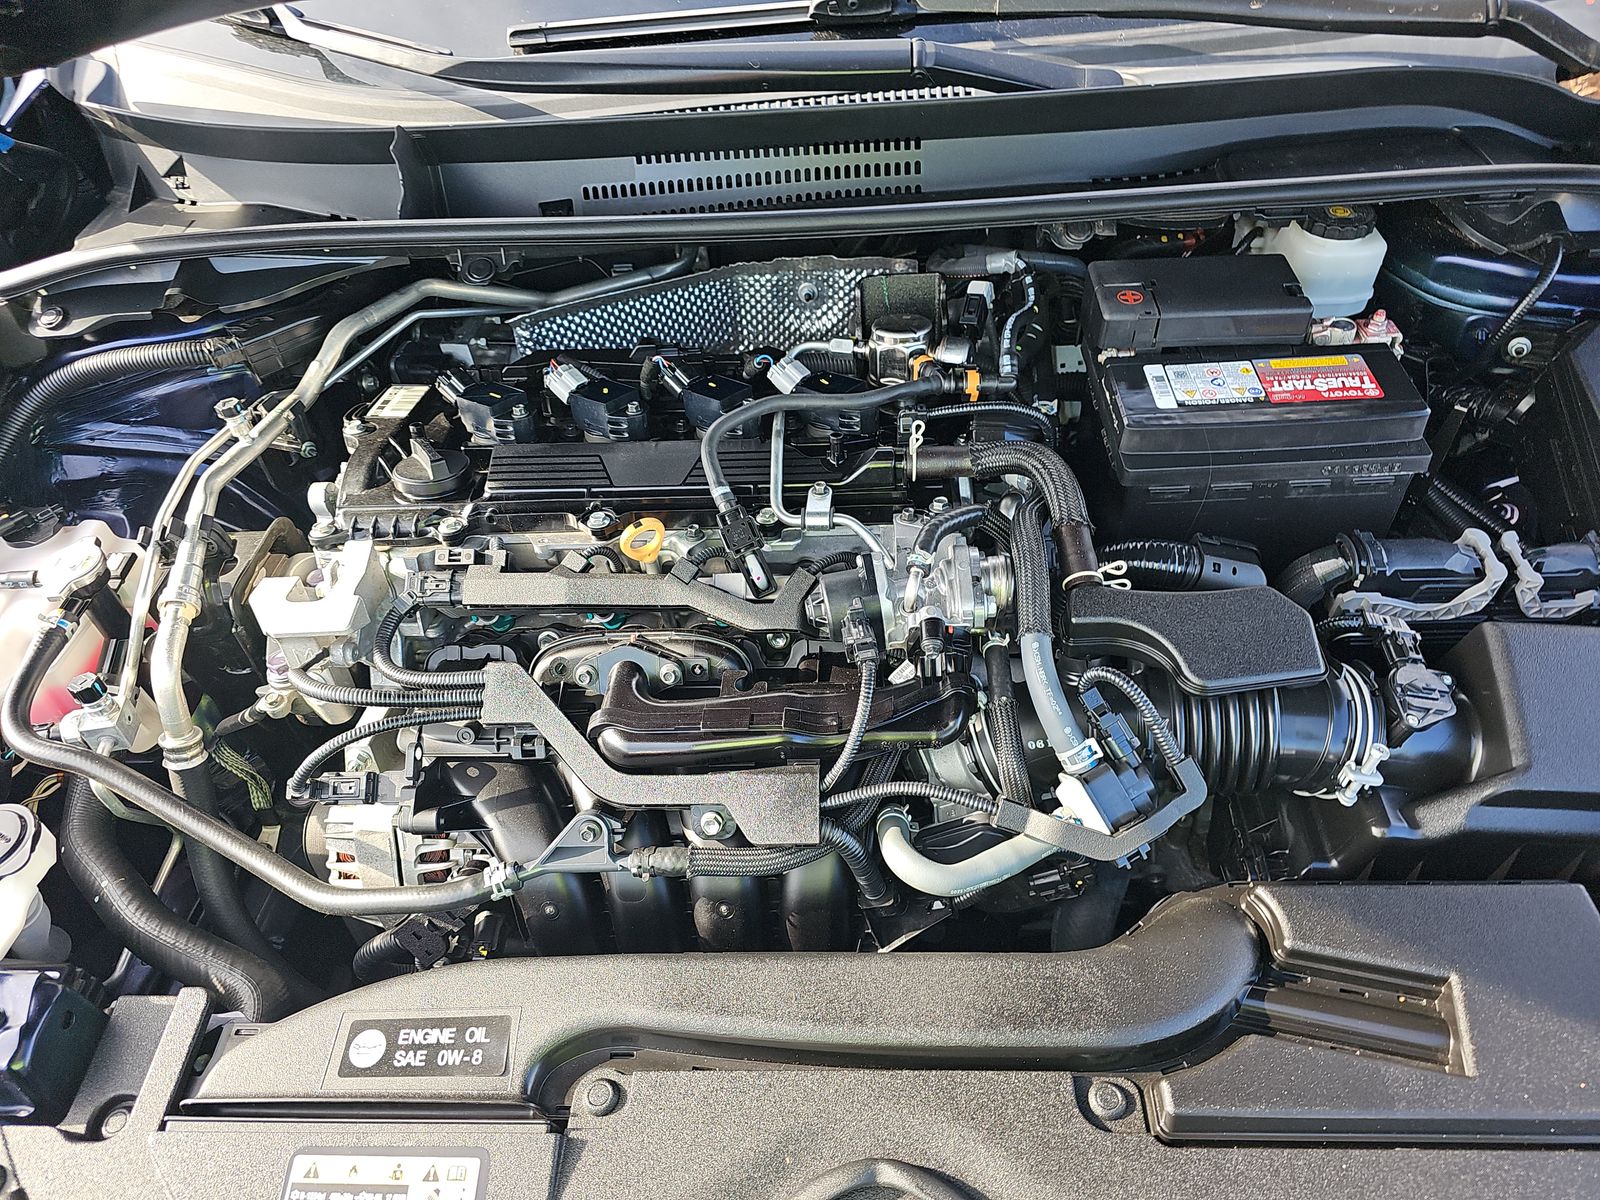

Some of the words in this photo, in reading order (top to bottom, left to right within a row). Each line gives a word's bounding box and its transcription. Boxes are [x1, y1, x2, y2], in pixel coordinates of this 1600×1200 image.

[1321, 389, 1364, 397] TOYOTA
[1185, 397, 1255, 406] DANGER/POISON
[398, 1028, 456, 1045] ENGINE
[465, 1026, 491, 1043] OIL
[393, 1050, 428, 1067] SAE
[437, 1049, 483, 1066] 0W-8
